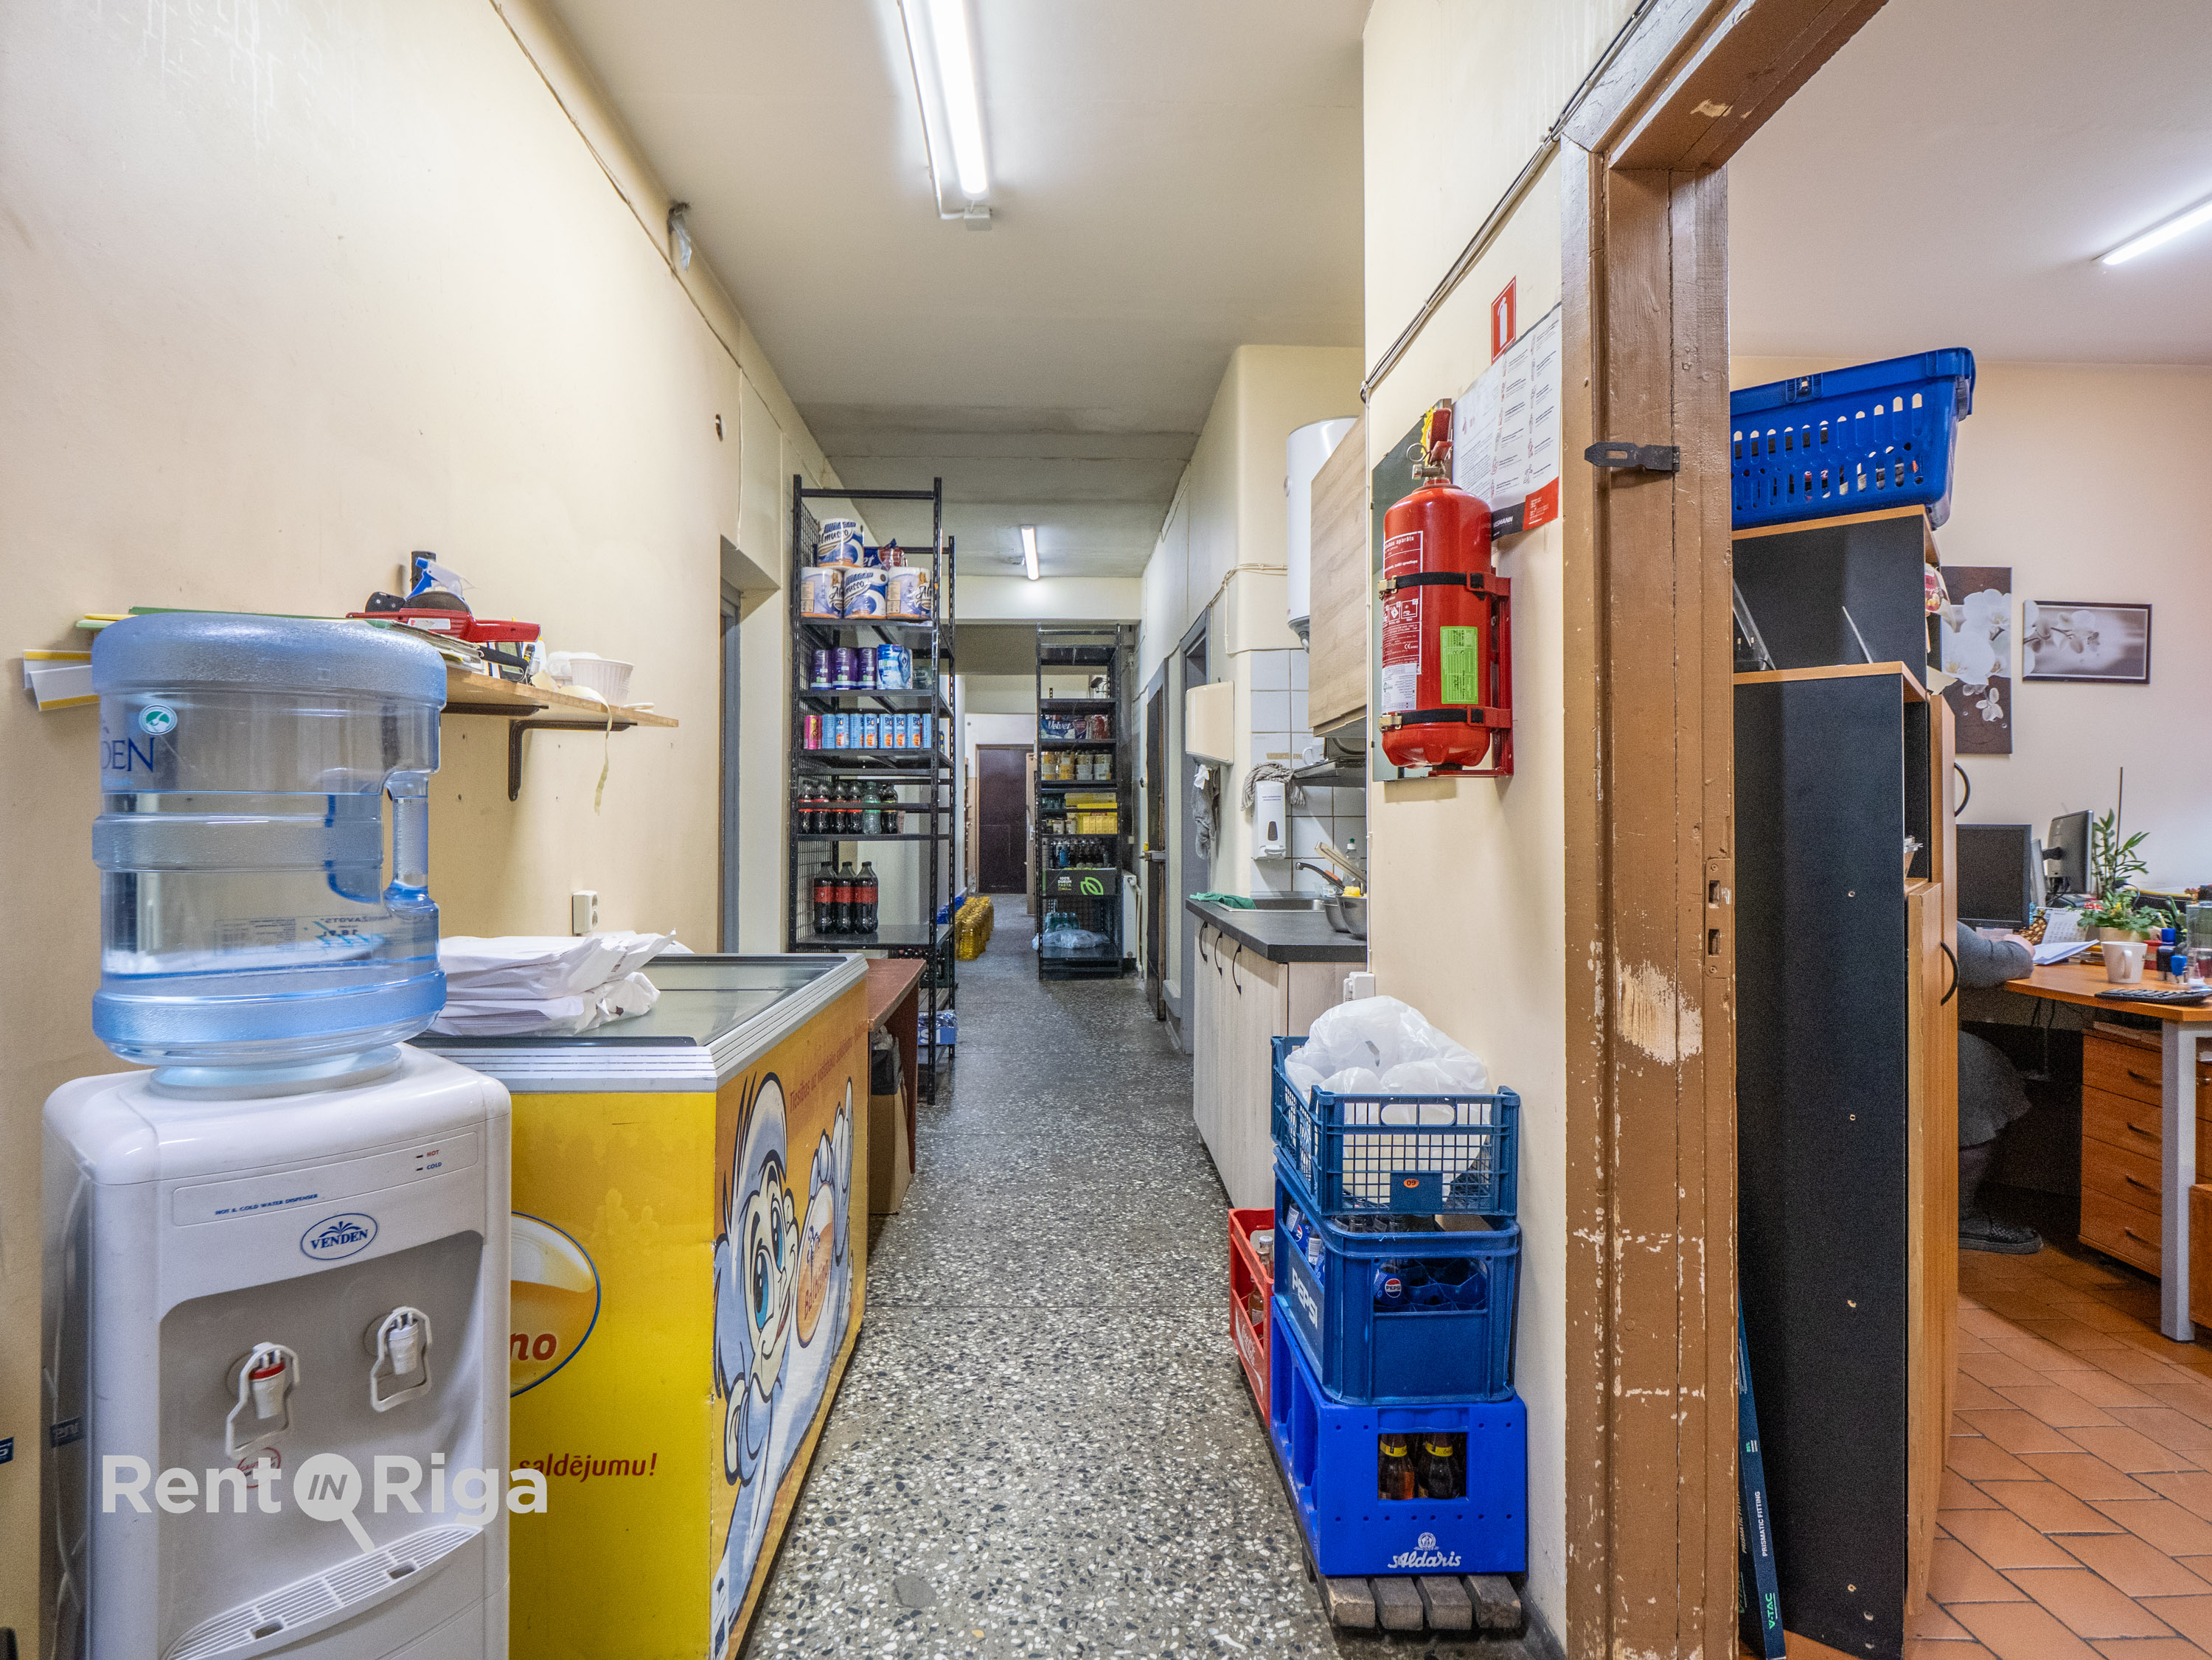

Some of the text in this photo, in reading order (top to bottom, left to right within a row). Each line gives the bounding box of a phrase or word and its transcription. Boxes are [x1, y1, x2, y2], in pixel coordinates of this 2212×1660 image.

[426, 1162, 442, 1171] COLD
[285, 1193, 319, 1204] DISPENSER
[310, 1229, 369, 1250] VENDEN
[1292, 1267, 1318, 1330] PEPSI
[519, 1453, 658, 1482] saldējumu!
[1755, 1490, 1768, 1557] PRISMATIC FITTING
[1388, 1551, 1461, 1568] Aldaris
[1765, 1593, 1775, 1630] V-TAC
